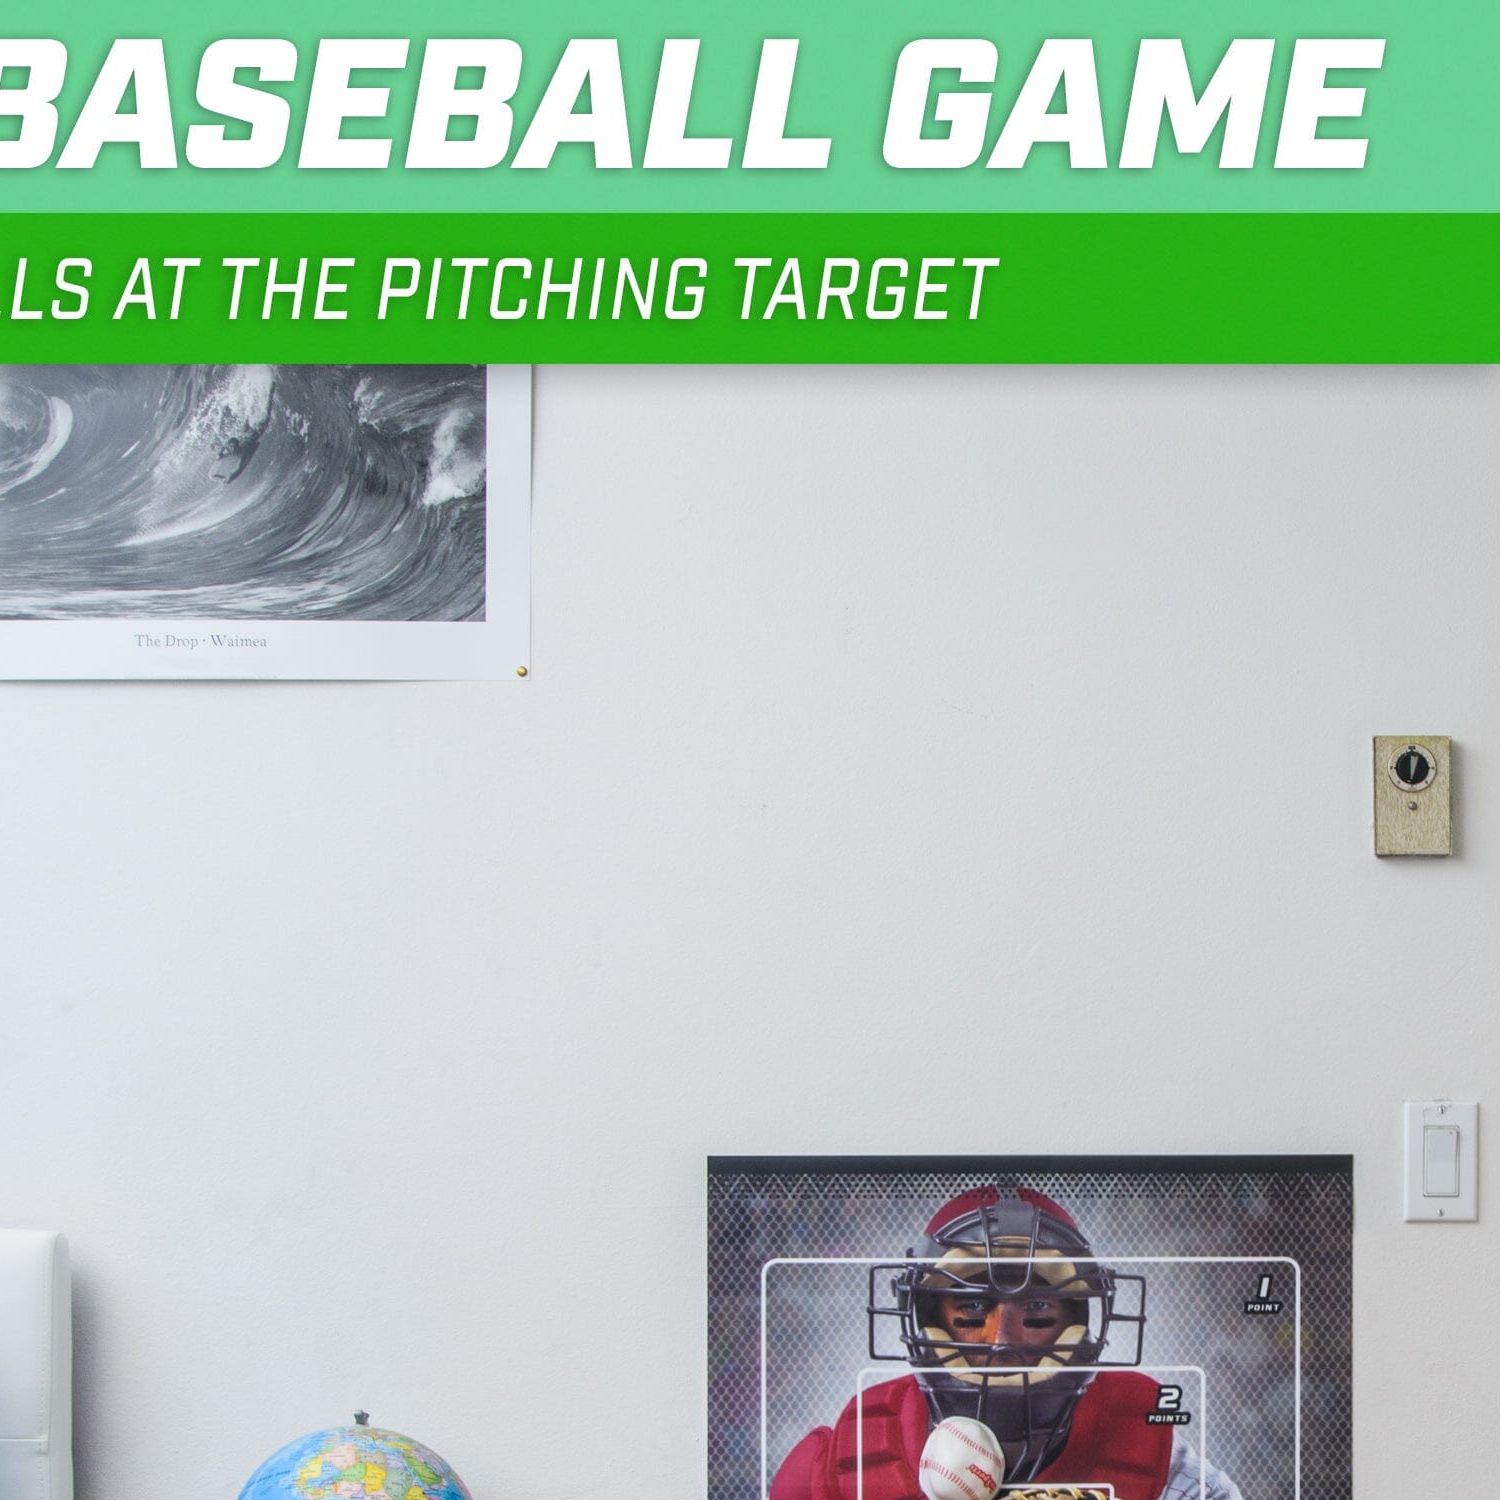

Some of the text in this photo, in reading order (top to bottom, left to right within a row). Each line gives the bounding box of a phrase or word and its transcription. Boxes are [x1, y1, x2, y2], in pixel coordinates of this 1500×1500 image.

[134, 634, 268, 650] The Drop Waimea
[1247, 1303, 1280, 1312] POINT
[1158, 1387, 1180, 1409] 2
[1148, 1414, 1189, 1423] POINTS
